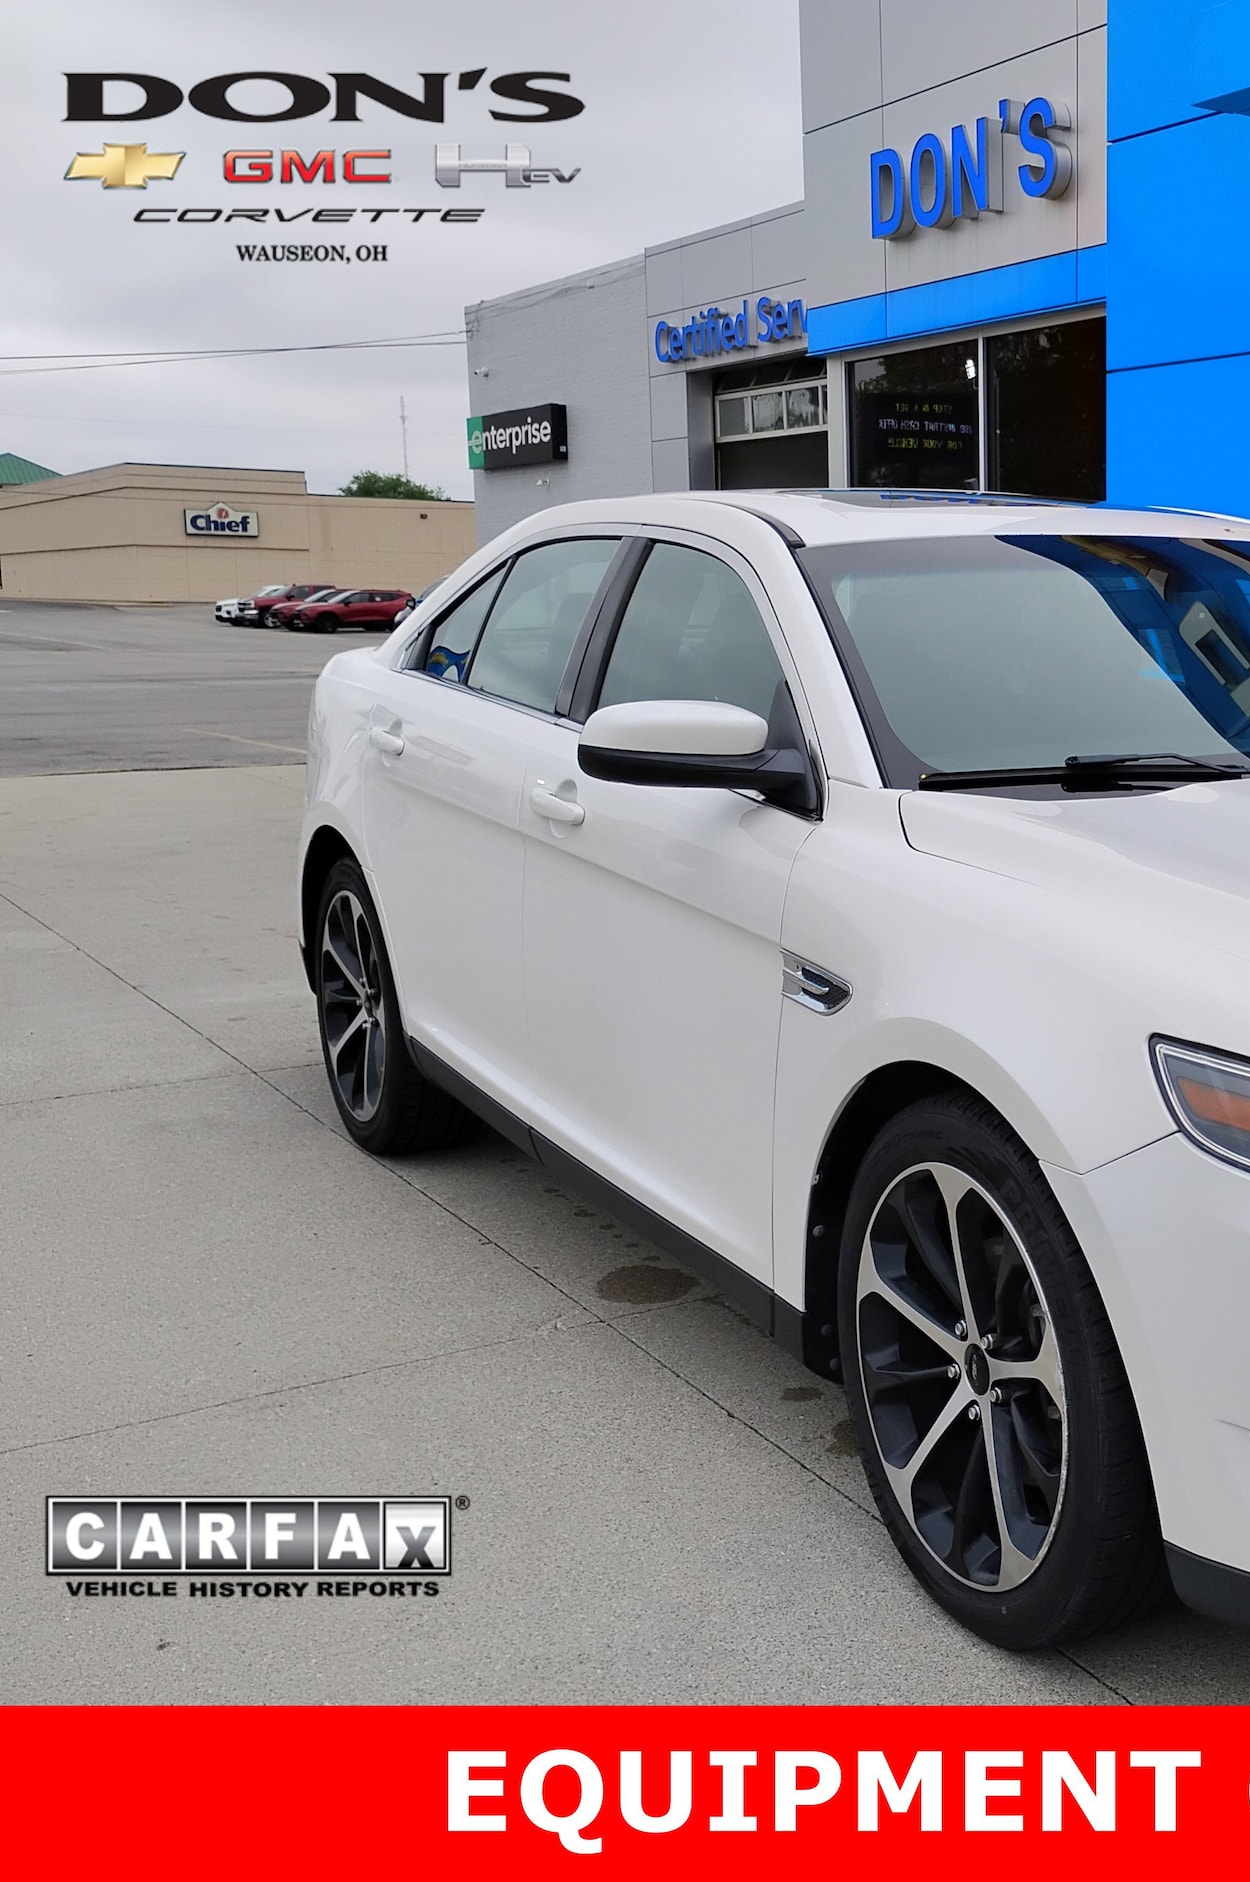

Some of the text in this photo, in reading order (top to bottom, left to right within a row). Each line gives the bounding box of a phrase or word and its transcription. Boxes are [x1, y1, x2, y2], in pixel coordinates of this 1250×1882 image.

[870, 96, 1066, 240] DON'S
[655, 299, 749, 363] Certified
[471, 416, 551, 454] enterprise
[190, 514, 251, 533] Chief
